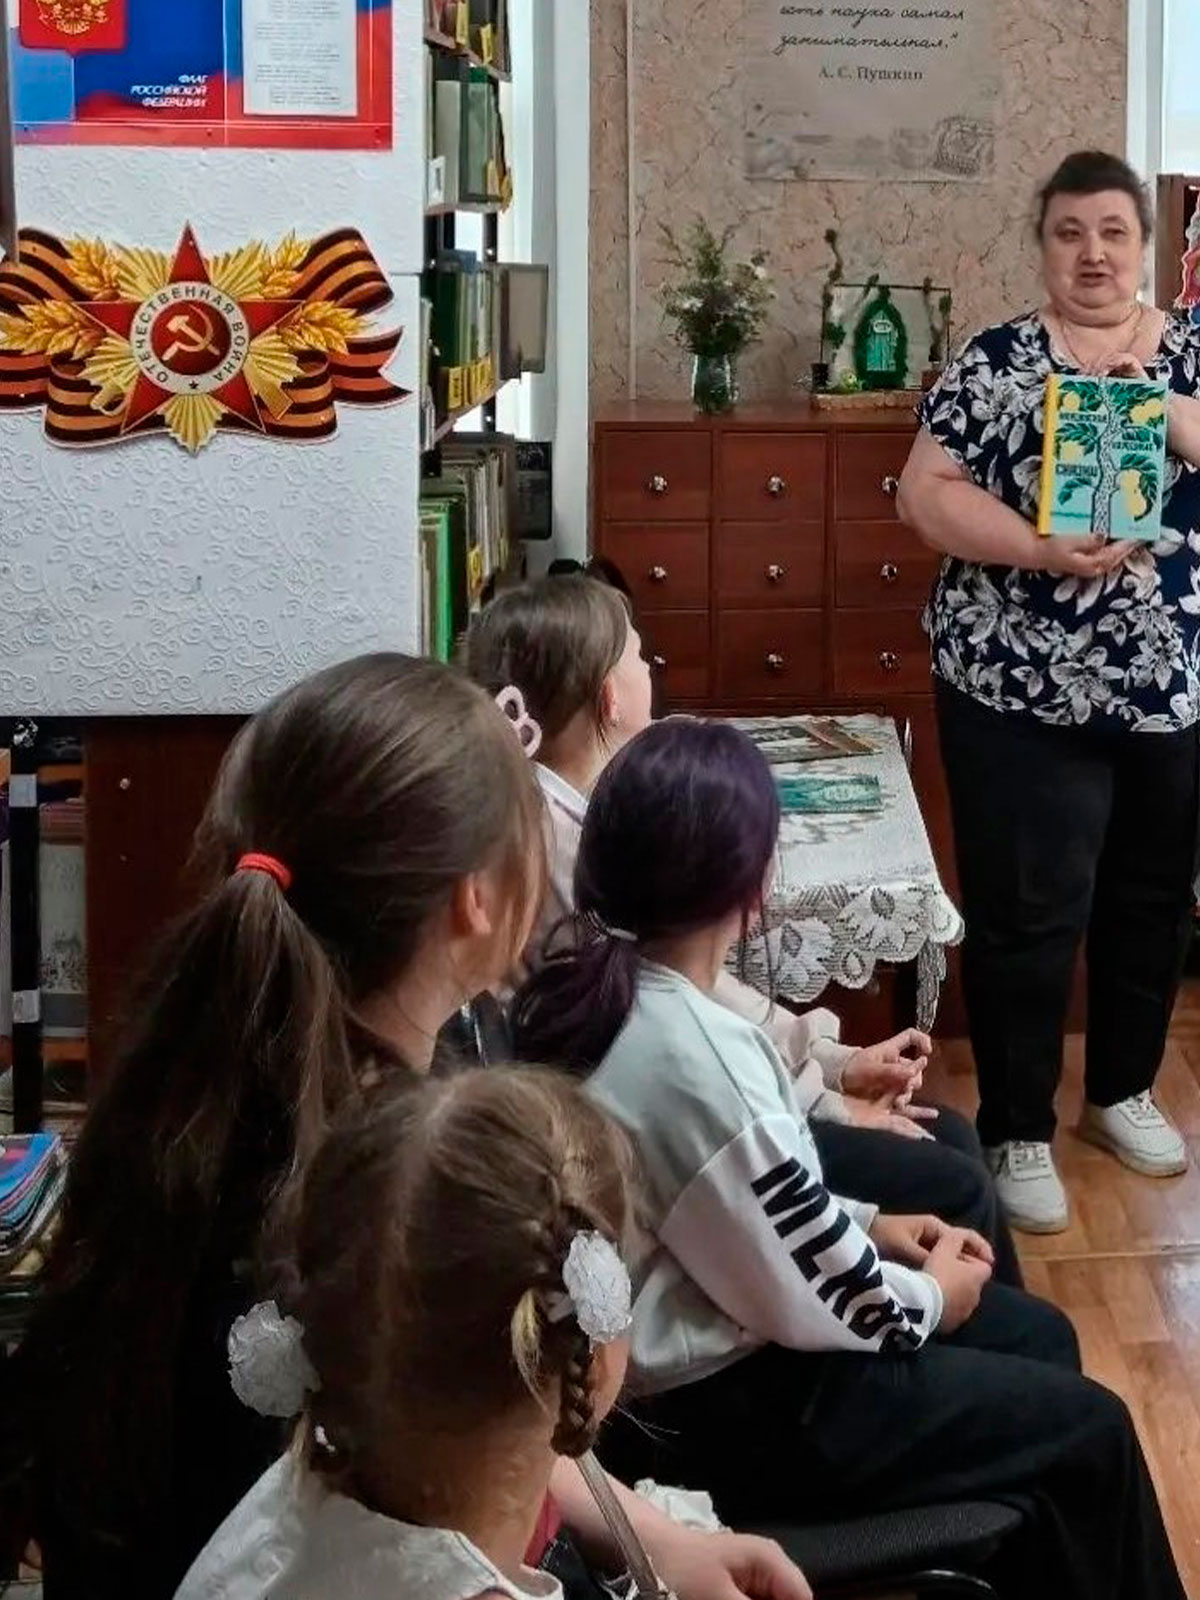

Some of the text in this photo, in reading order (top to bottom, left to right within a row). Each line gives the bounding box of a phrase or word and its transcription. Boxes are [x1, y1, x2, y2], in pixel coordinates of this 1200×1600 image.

[831, 7, 894, 28] наука
[900, 7, 964, 20] самая
[178, 74, 208, 84] ФЛАГ
[818, 65, 923, 83] А. С. Пушкин
[130, 84, 207, 96] РОССИЙСКОЙ
[135, 286, 235, 384] ОТЕЧЕСТВЕННАЯ
